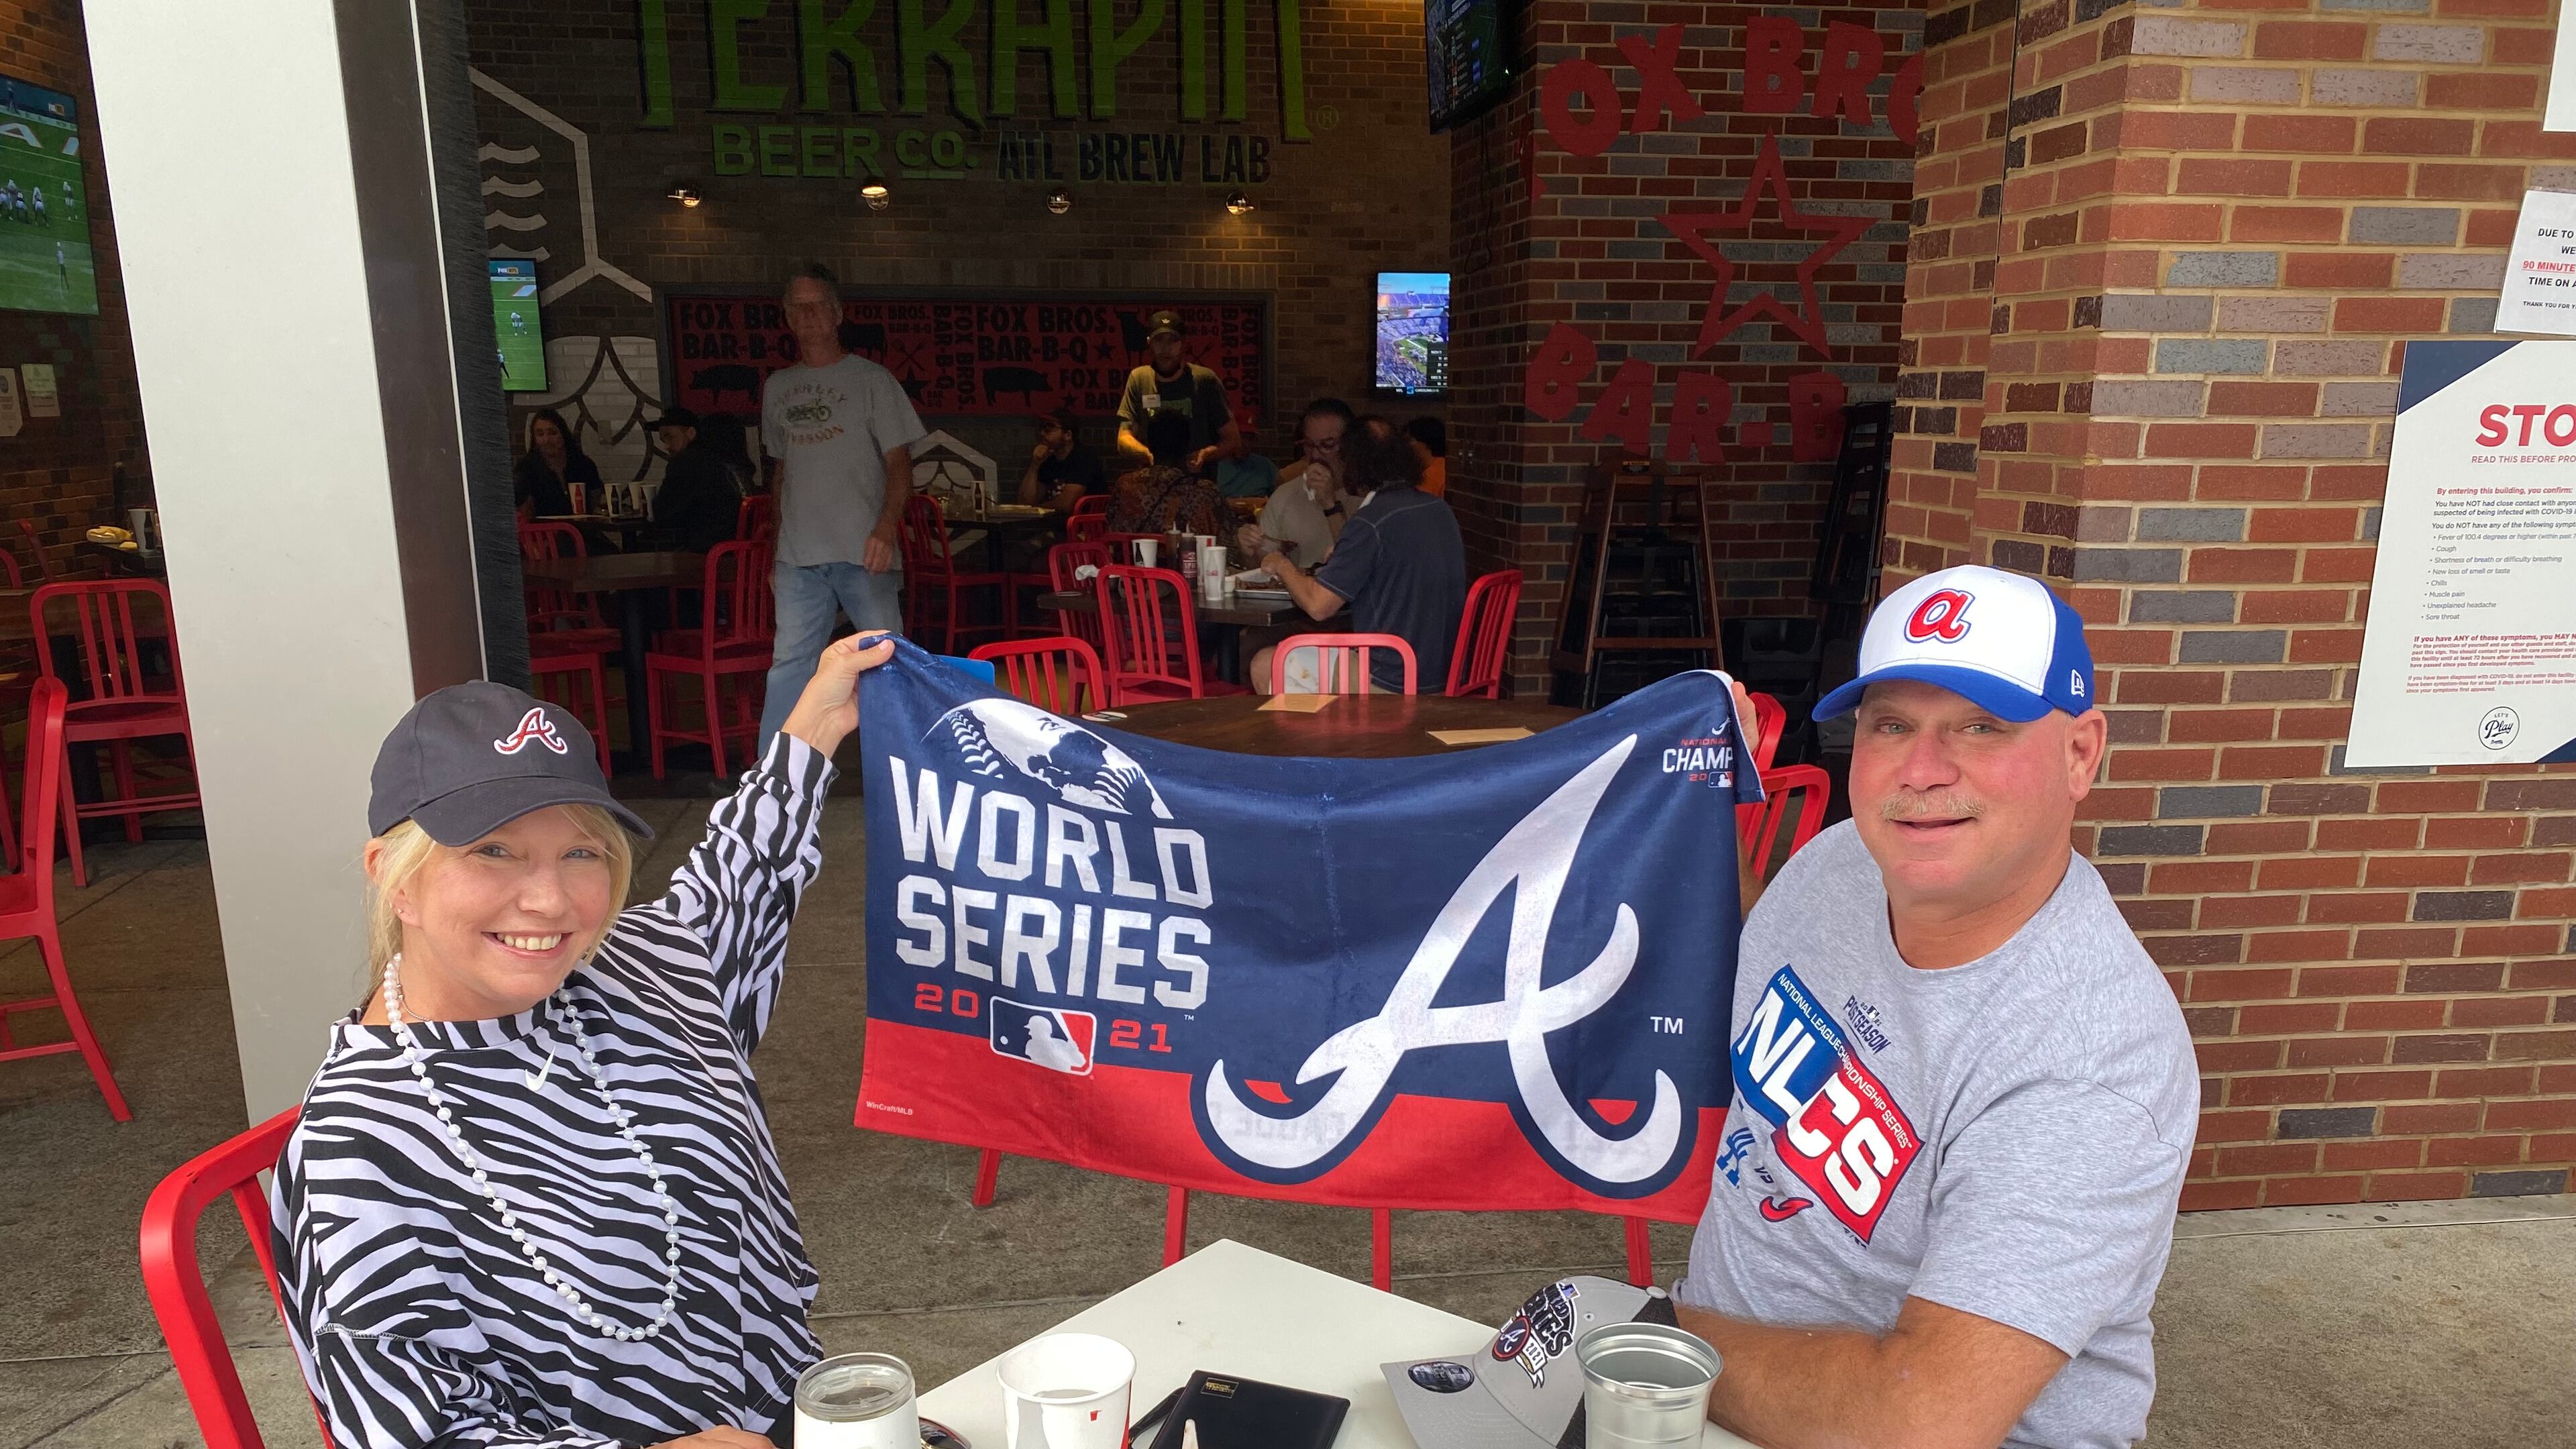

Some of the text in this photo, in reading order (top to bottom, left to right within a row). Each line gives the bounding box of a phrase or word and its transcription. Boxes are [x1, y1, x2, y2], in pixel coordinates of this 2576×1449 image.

[711, 125, 1271, 185] BEER CO. ATL BREW LAB
[2538, 229, 2573, 238] DUE TO
[2523, 260, 2534, 269] 90
[2529, 277, 2569, 287] TIME ON
[680, 303, 732, 329] FOX
[854, 305, 931, 320] FOX BROS.
[954, 305, 973, 344] FOX
[977, 306, 1028, 332] FOX
[1038, 306, 1116, 333] BROS.
[683, 333, 802, 362] BAR-B-Q
[977, 335, 1088, 364] BAR-B-Q
[1059, 368, 1099, 389] FOX
[2484, 720, 2514, 739] Play
[1688, 773, 1707, 782] 20
[889, 755, 1214, 910] WORLD
[896, 874, 1212, 1010] SERIES
[914, 983, 979, 1019] 20
[1778, 973, 1812, 1019] NATIONAL
[1810, 1014, 1842, 1051] LEAGUE
[1109, 1019, 1172, 1053] 21
[1650, 1016, 1683, 1034] TM
[866, 1101, 913, 1116] WinCraft/MLB
[1737, 987, 1894, 1216] NLCS
[1525, 1342, 1544, 1366] 2021
